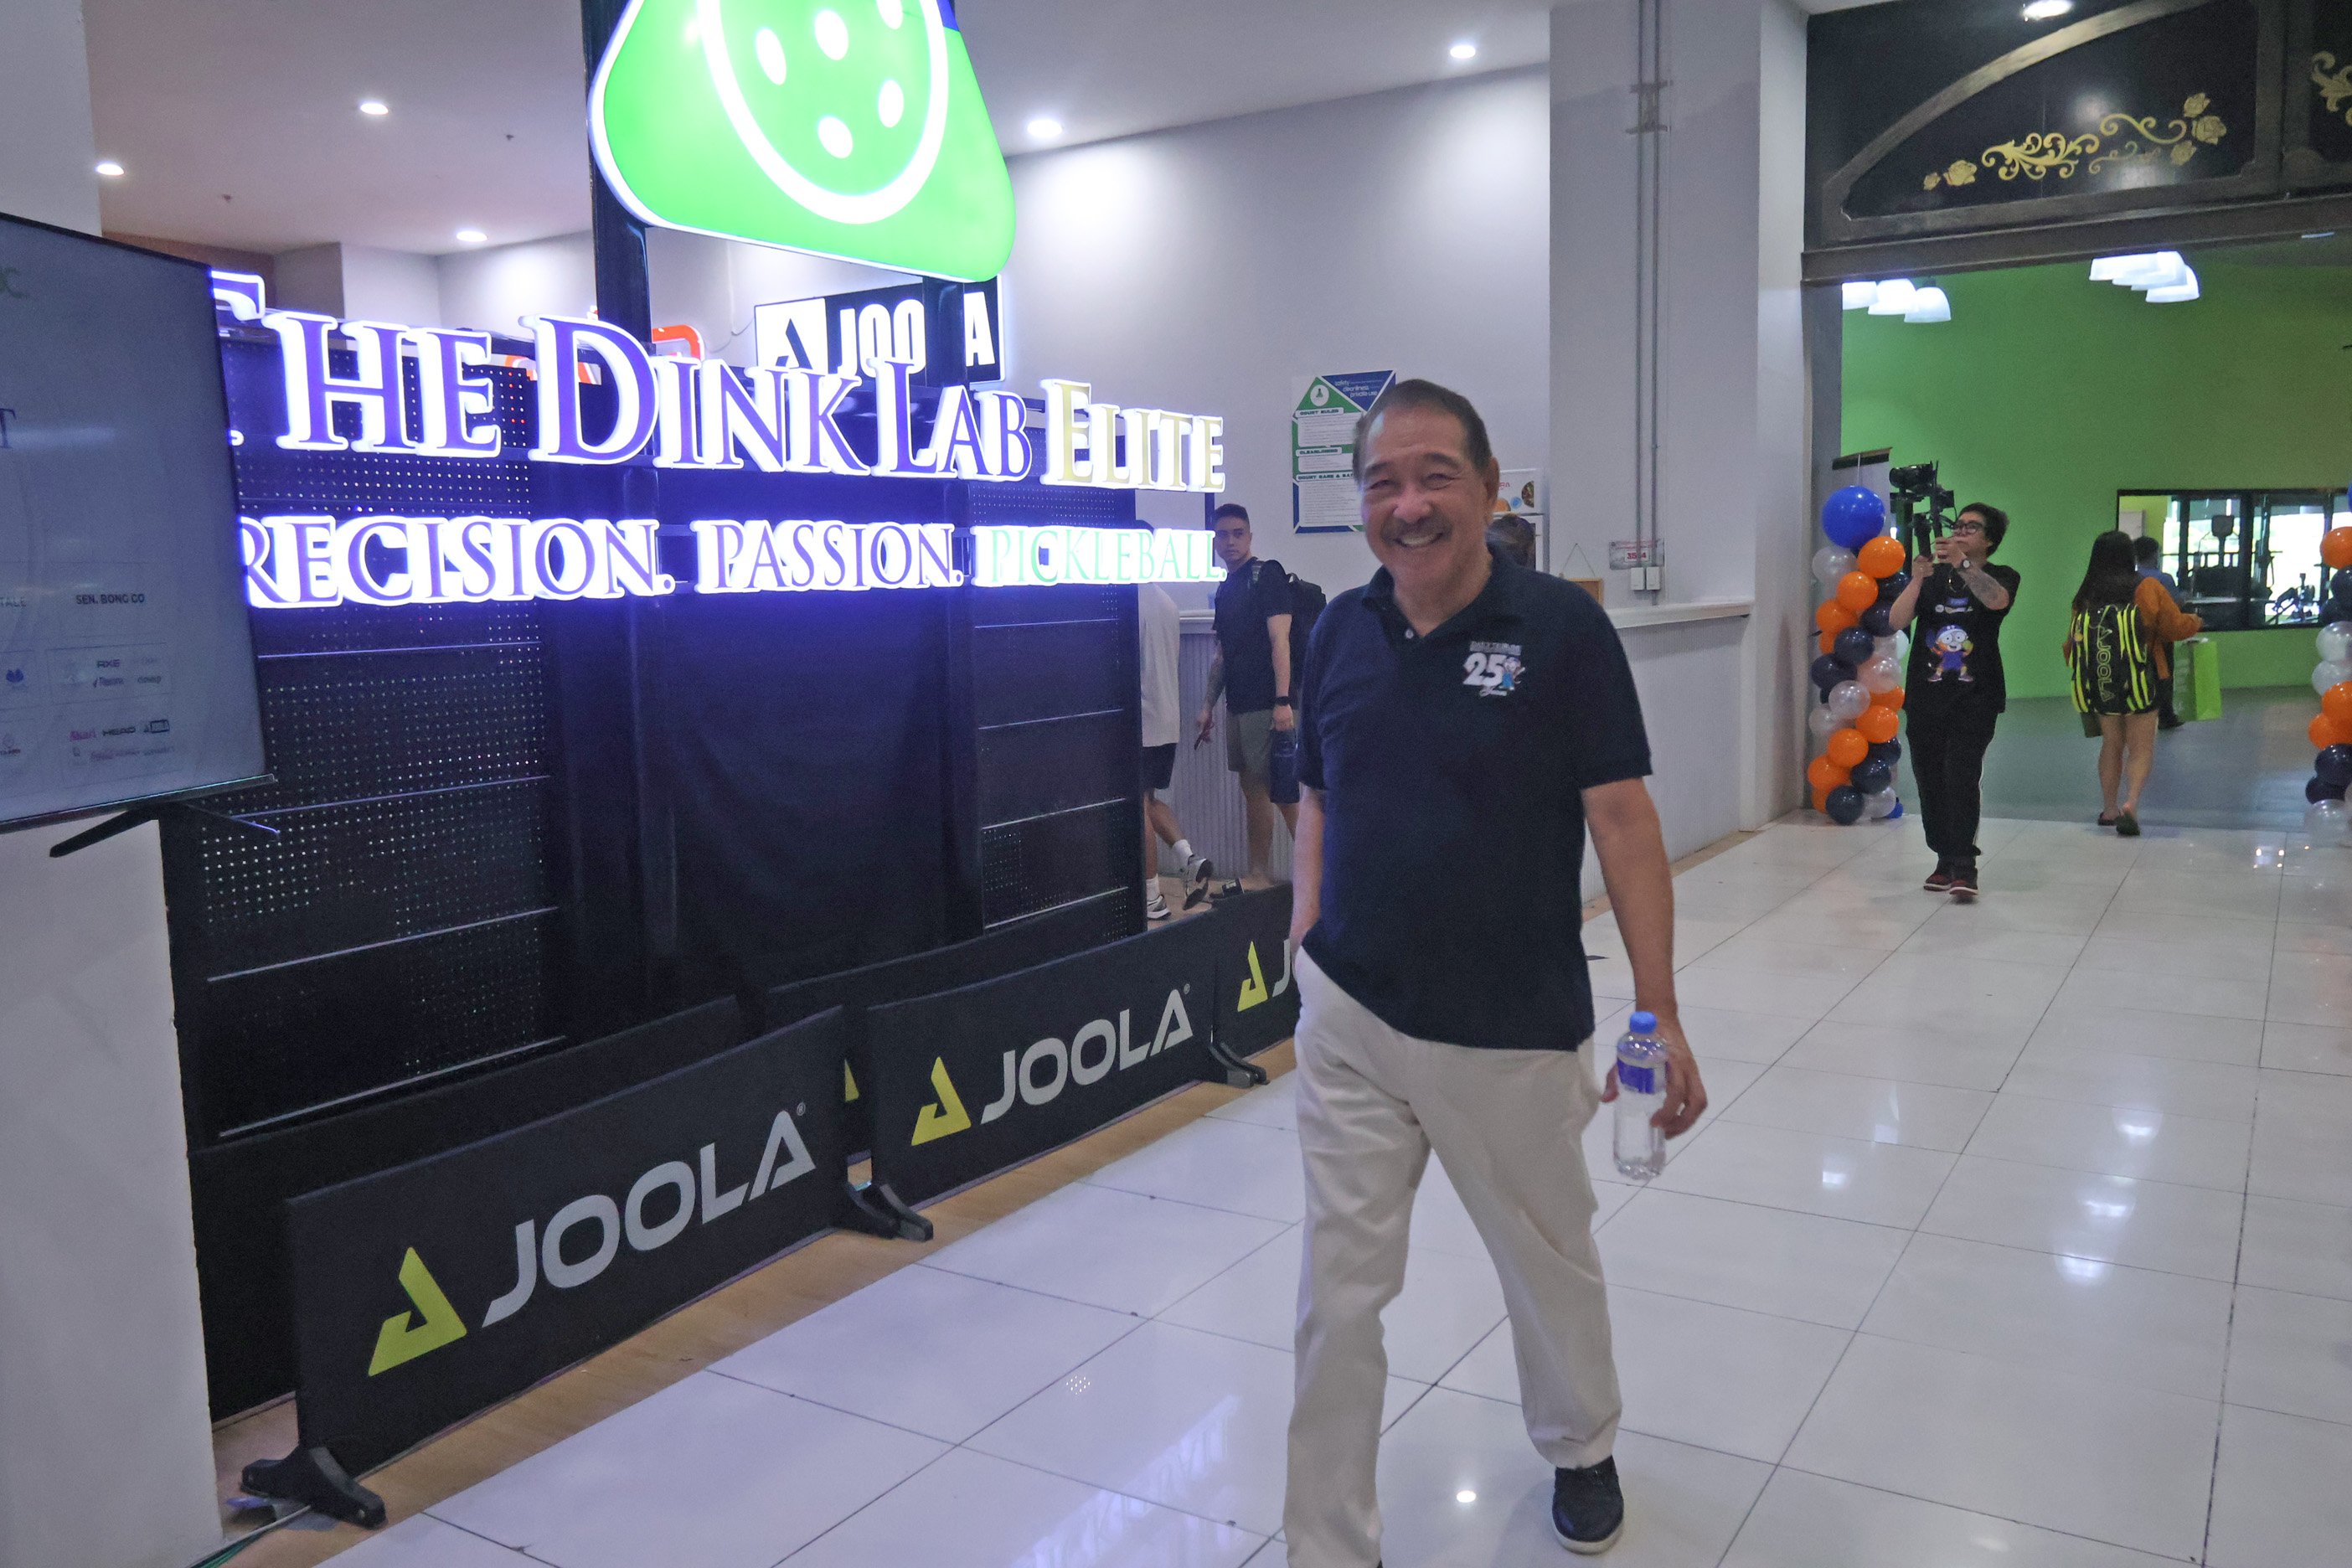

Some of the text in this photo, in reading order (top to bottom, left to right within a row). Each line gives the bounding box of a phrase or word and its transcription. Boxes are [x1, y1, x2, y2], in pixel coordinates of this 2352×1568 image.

[838, 291, 995, 379] JOOA
[211, 271, 501, 457] HE
[1039, 379, 1225, 493] ELITE
[76, 594, 98, 605] SEN.
[691, 519, 963, 593] PASSION.
[970, 524, 1228, 585] PICKLEBALL.
[1462, 652, 1507, 687] 25
[981, 988, 1193, 1125] JOOLA
[482, 1110, 816, 1328] JOOLA
